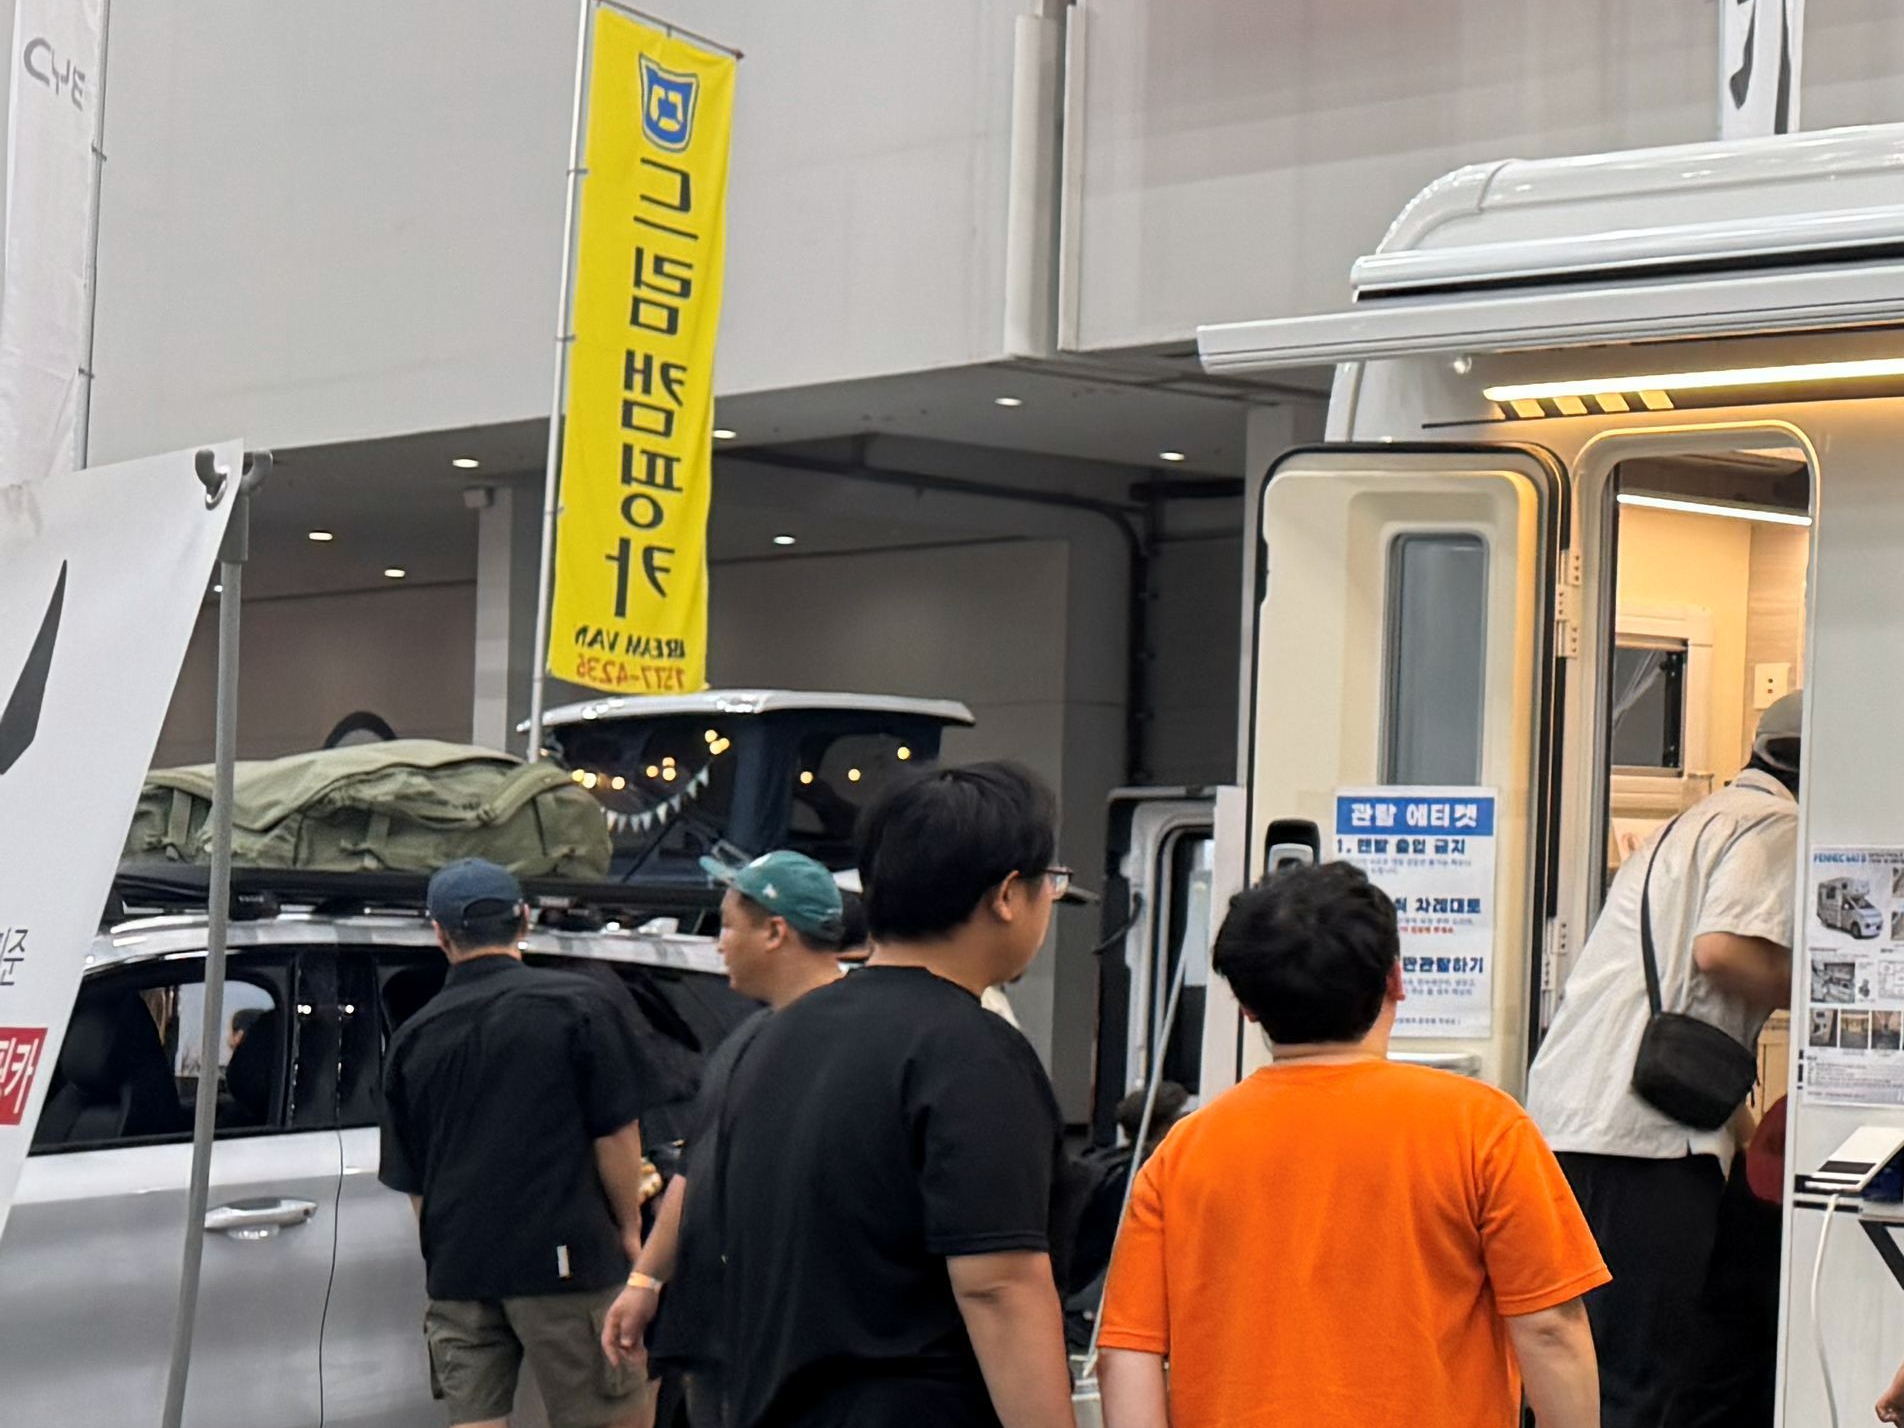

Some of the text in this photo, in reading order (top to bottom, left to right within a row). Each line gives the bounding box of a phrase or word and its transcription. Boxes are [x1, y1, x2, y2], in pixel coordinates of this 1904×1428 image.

[1350, 802, 1478, 829] 관람 에티켓
[1434, 838, 1466, 855] 금지
[1416, 897, 1482, 915] 차례대로
